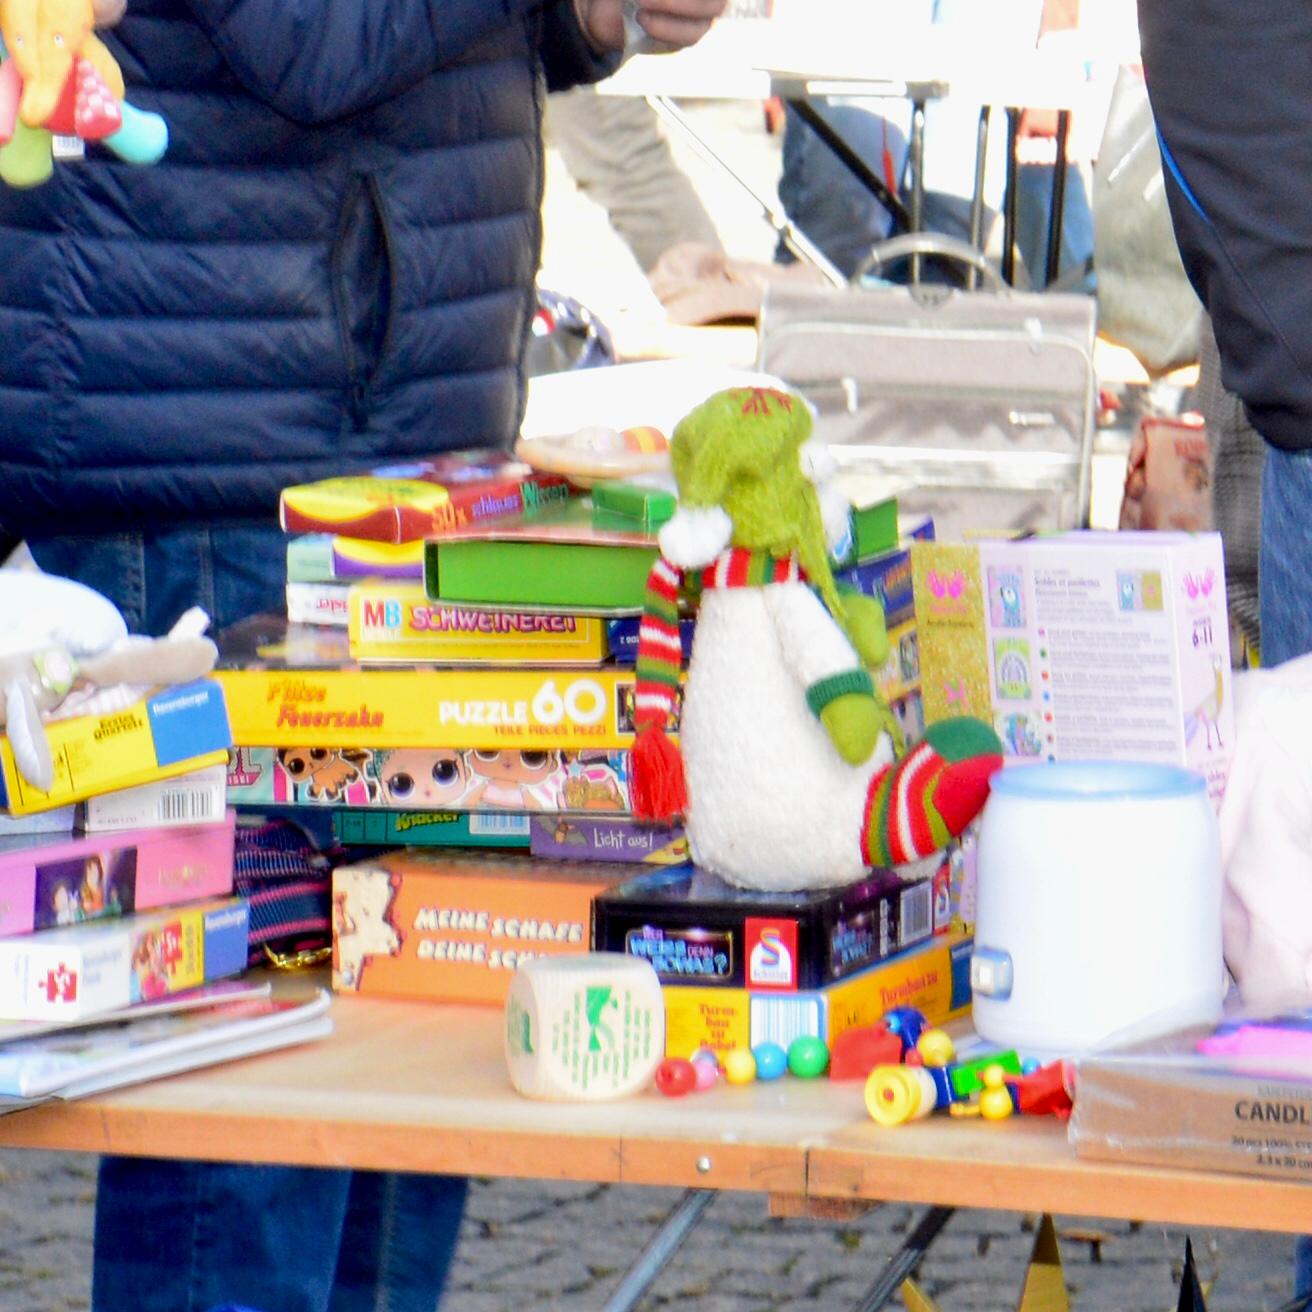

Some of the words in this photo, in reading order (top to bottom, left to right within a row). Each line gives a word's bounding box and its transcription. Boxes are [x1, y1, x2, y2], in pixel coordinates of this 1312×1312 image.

[363, 599, 400, 628] MB
[439, 699, 528, 725] PUZZLE
[532, 679, 607, 725] 60
[593, 827, 625, 849] Licht
[627, 831, 653, 852] aus!
[413, 907, 489, 932] MEINE
[490, 918, 583, 943] SCHAFE
[416, 939, 486, 963] DEINE
